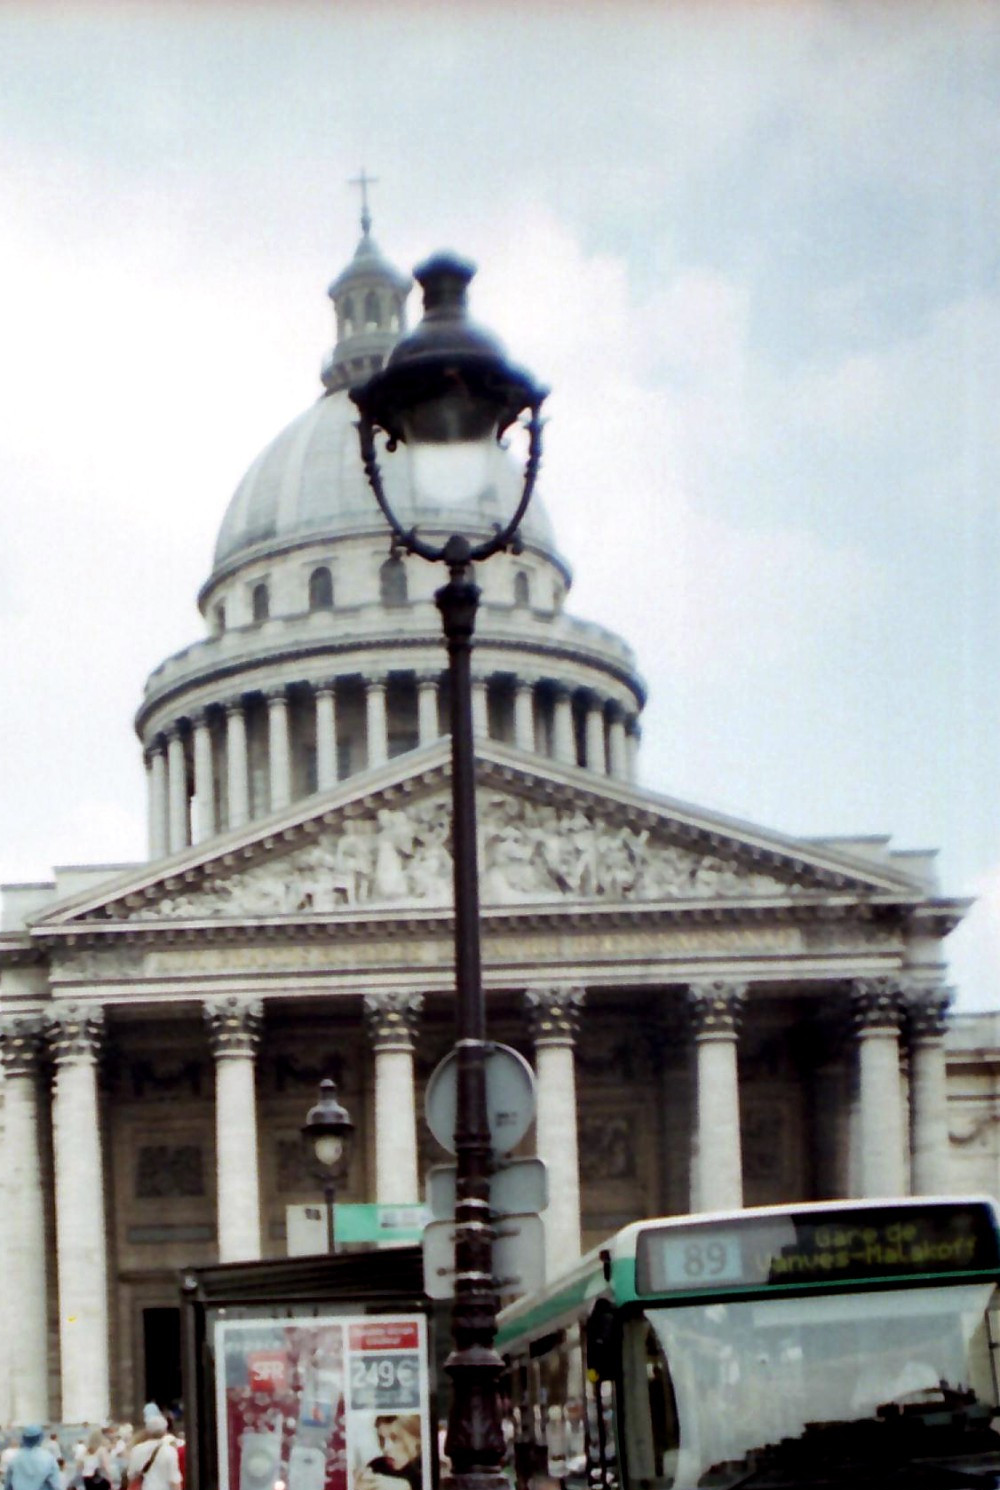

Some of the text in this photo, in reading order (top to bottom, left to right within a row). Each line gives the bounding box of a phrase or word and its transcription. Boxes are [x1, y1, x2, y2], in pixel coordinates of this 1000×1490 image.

[814, 1222, 917, 1248] Gare de
[683, 1241, 727, 1277] 89
[251, 1360, 285, 1381] SFR
